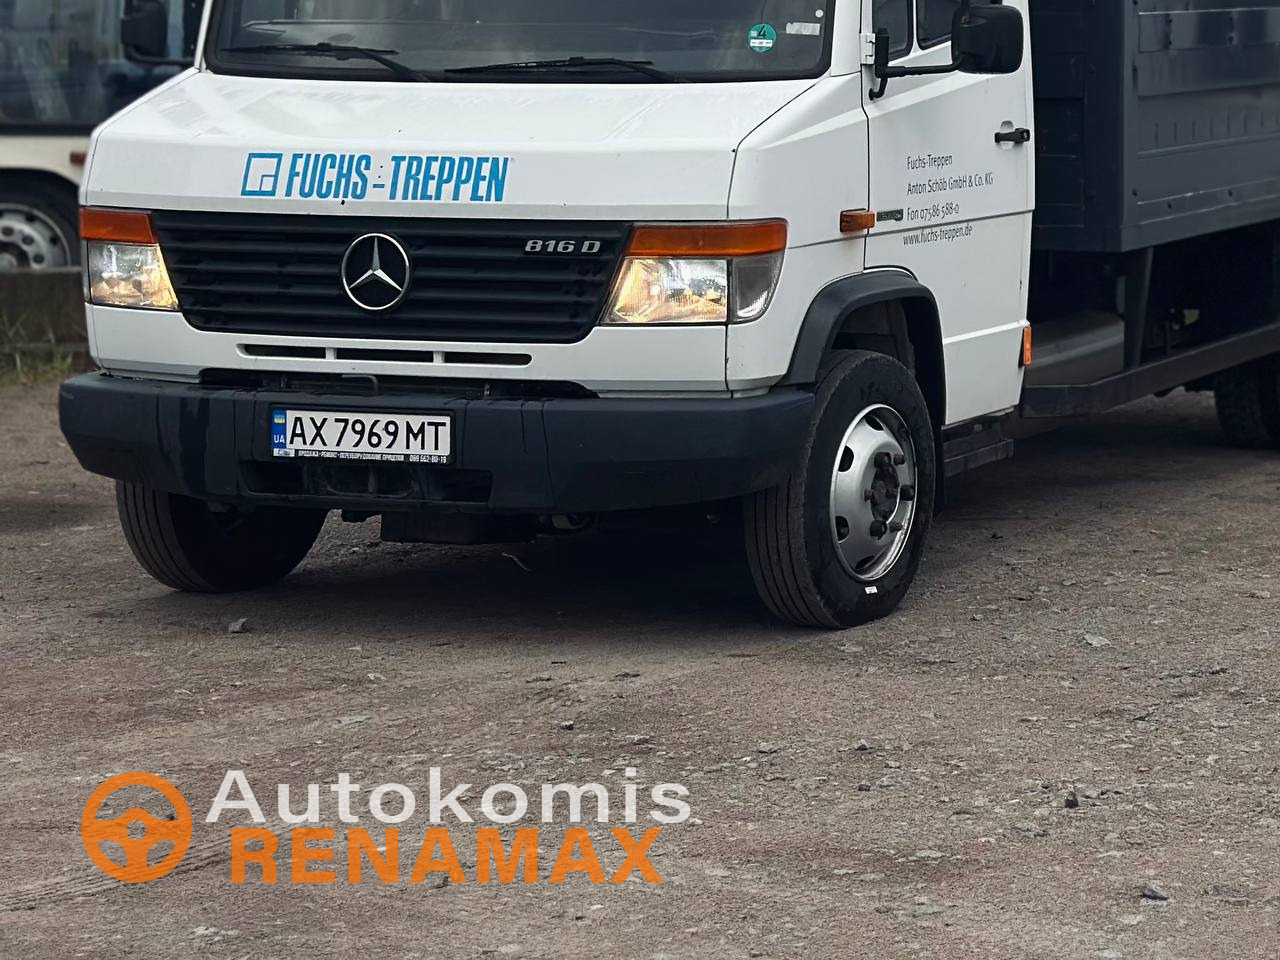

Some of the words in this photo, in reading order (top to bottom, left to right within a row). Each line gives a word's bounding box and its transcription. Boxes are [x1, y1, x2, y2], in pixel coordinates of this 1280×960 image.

[907, 154, 952, 170] Fuchs-Treppen
[907, 183, 926, 195] Anton
[948, 176, 967, 190] GmbH
[907, 207, 918, 220] Fon
[903, 222, 972, 245] www.fuchs-treppen.de
[525, 239, 576, 253] 816
[581, 240, 600, 253] D
[274, 435, 285, 443] UA
